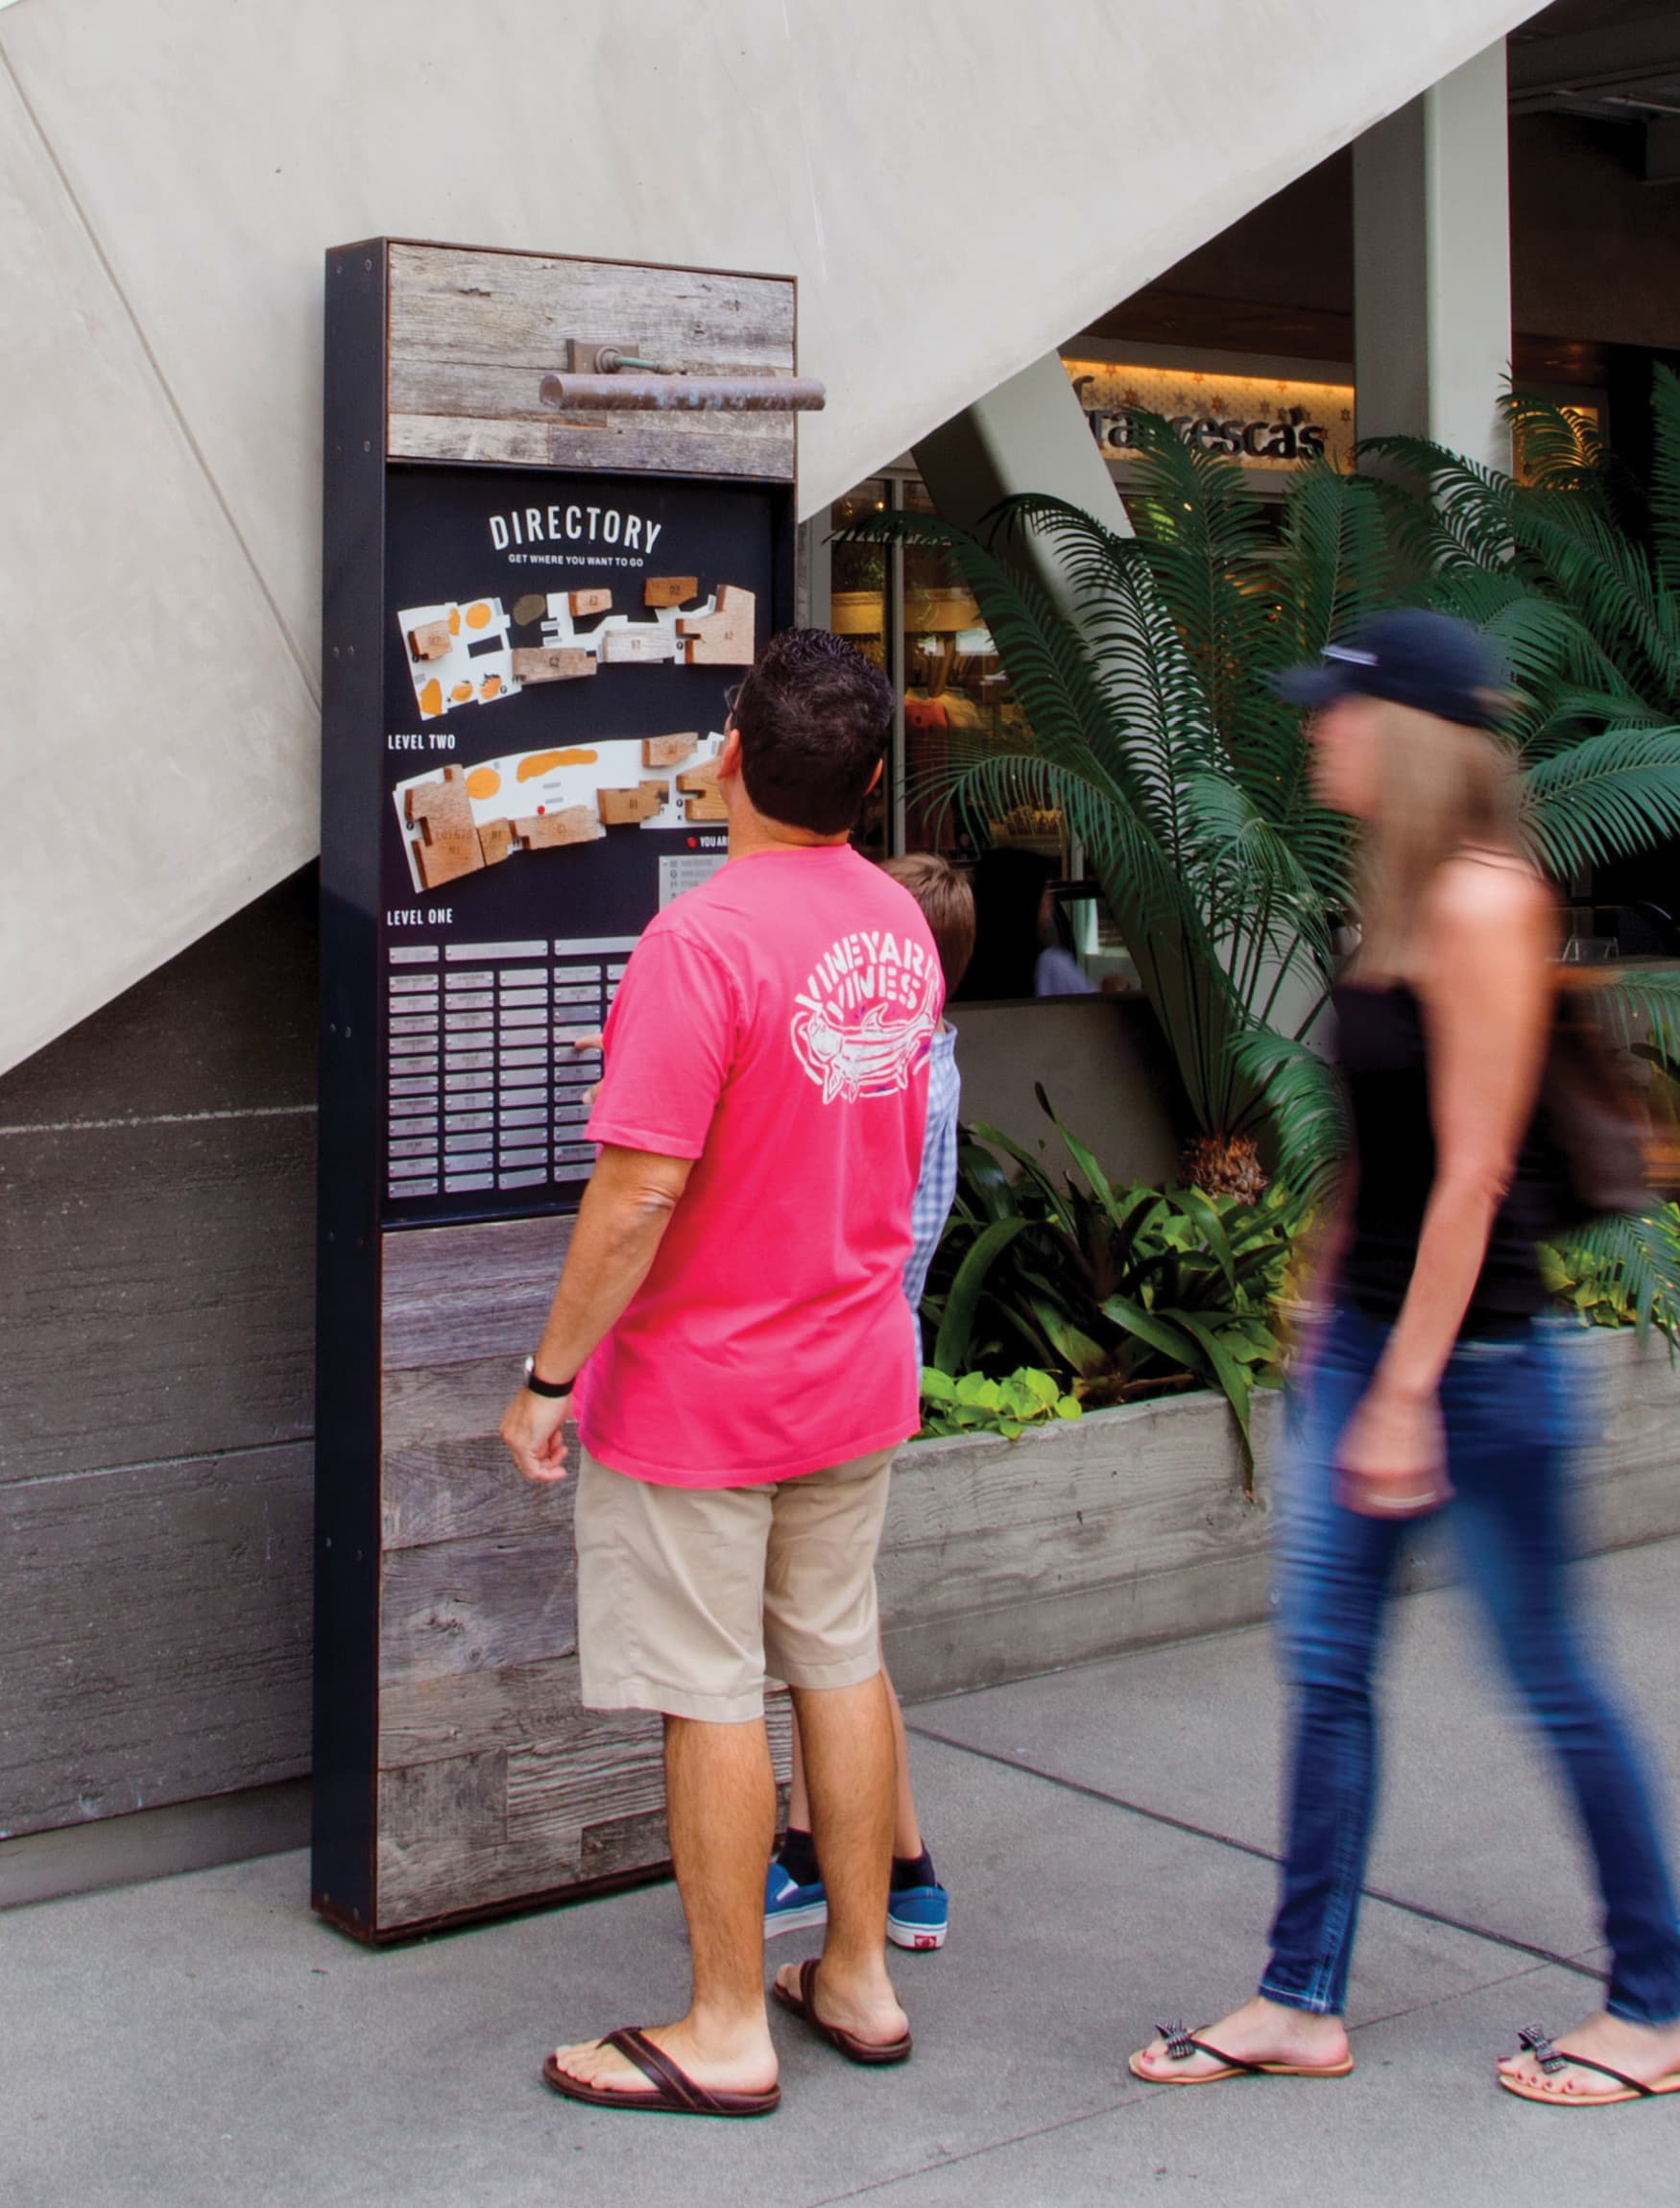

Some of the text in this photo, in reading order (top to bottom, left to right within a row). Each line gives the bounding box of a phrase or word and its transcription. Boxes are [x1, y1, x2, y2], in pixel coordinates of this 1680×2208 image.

[489, 505, 661, 554] DIRECTORY
[508, 554, 644, 567] GET WHERE YOU WANT TO GO
[388, 734, 456, 750] LEVEL TWO
[700, 836, 716, 847] YOU
[387, 907, 453, 926] LEVEL ONE
[827, 965, 922, 1021] VINES
